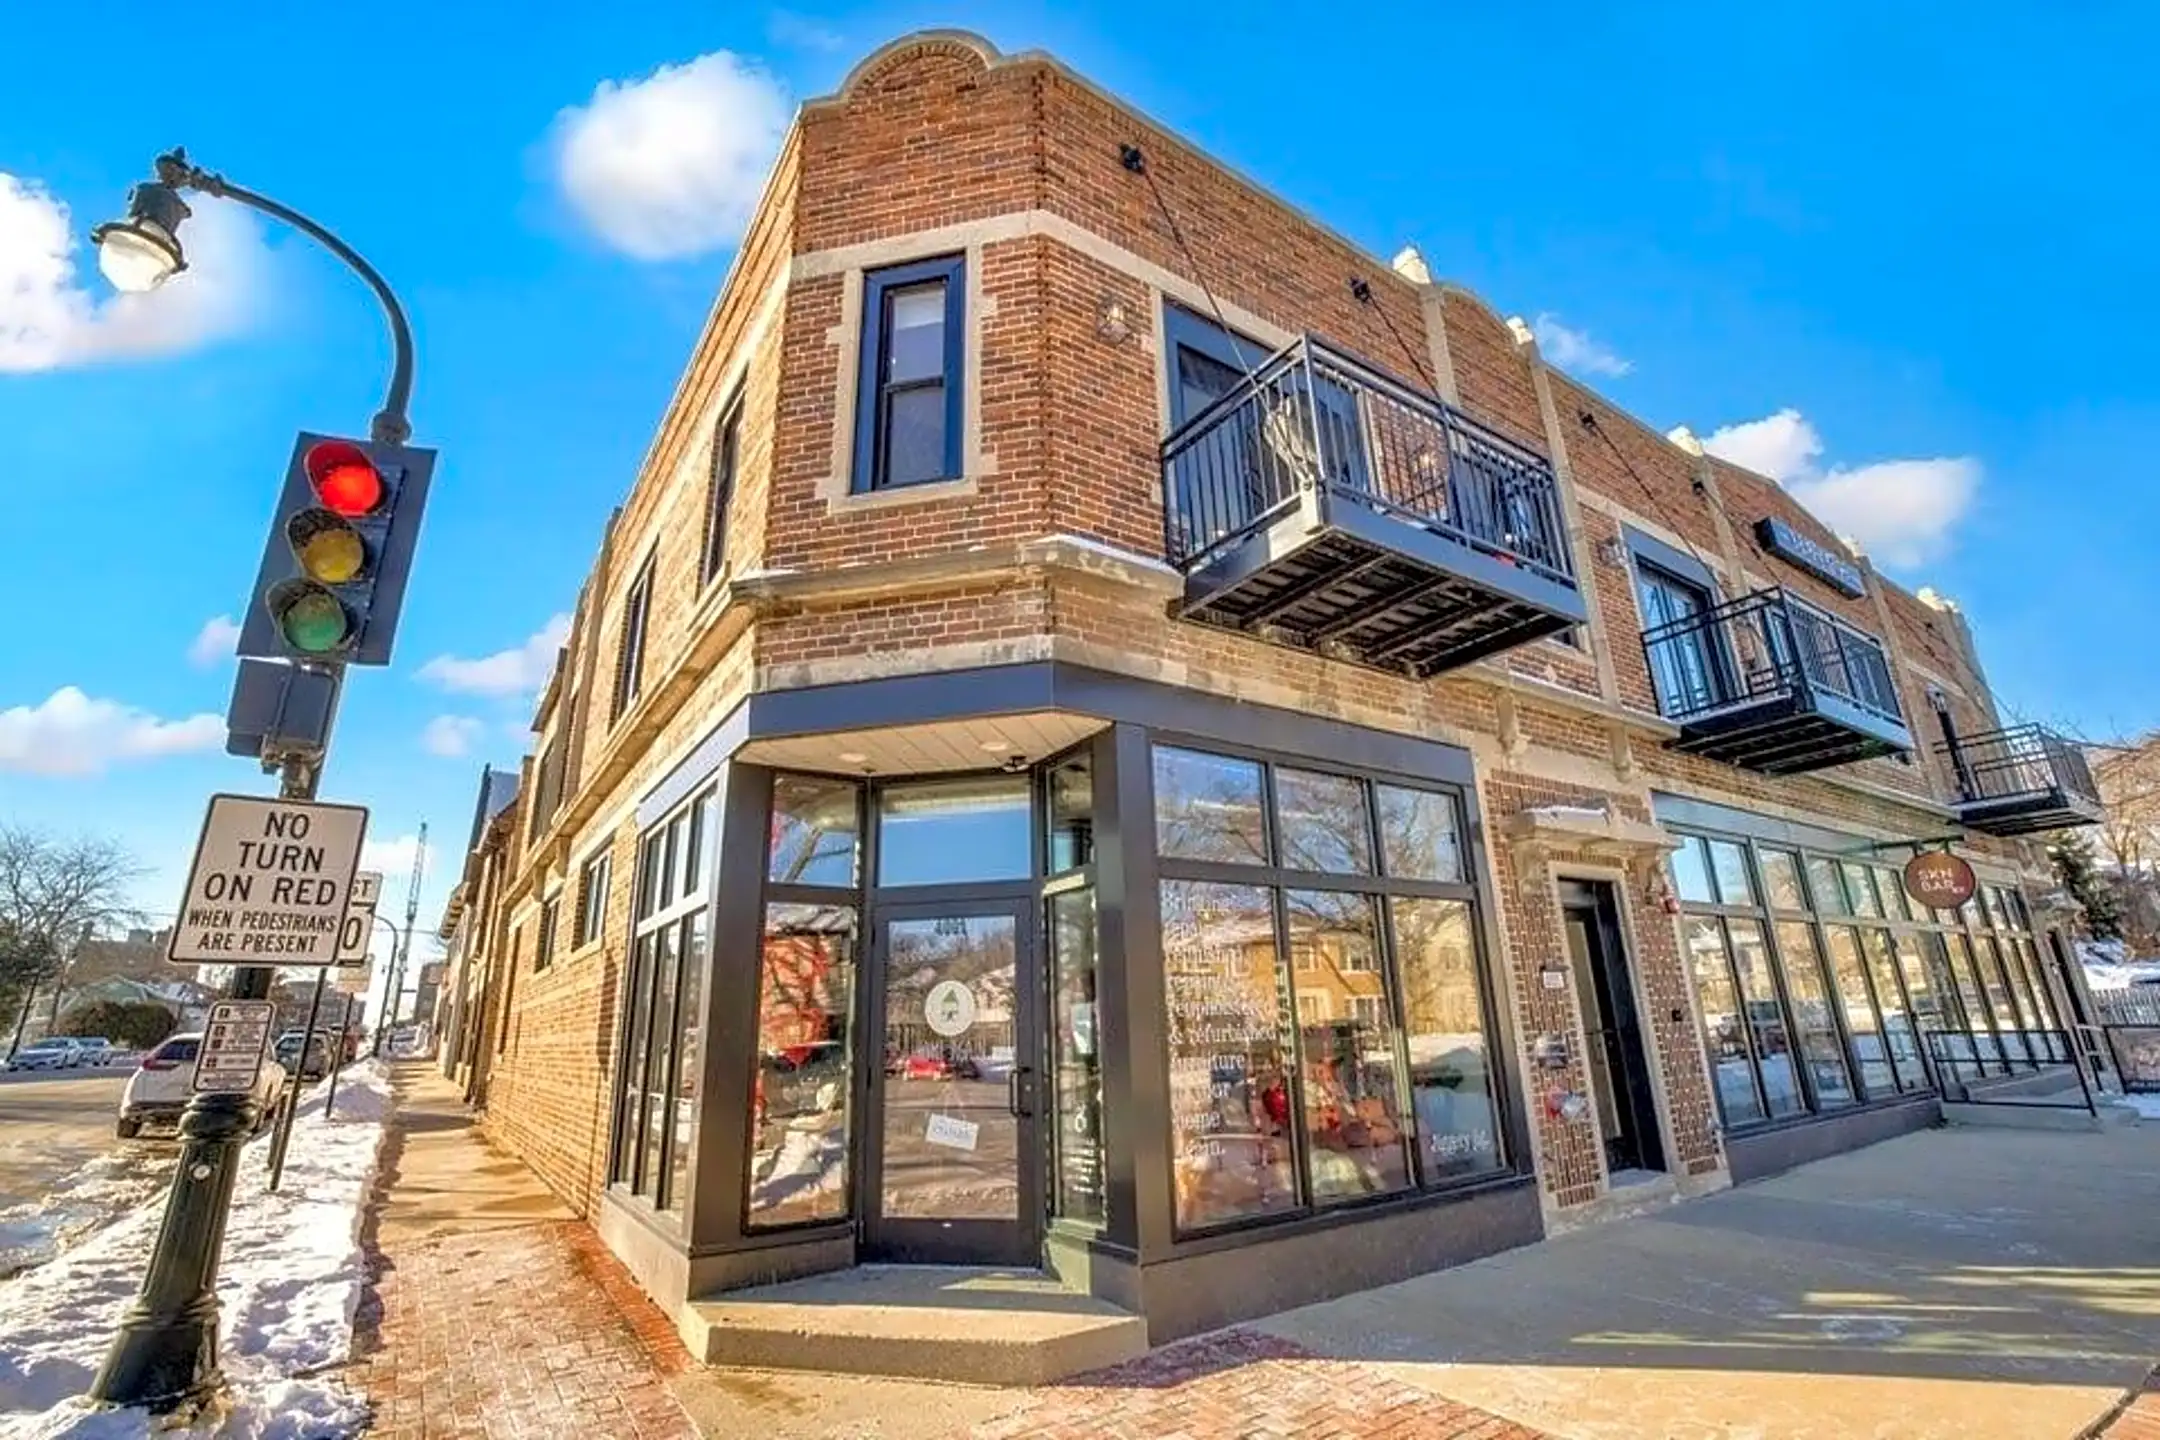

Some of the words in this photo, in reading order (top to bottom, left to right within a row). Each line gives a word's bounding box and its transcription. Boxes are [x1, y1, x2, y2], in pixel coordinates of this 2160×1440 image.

[265, 811, 309, 839] NO
[239, 841, 325, 873] TURN
[204, 873, 253, 901] ON
[272, 878, 336, 906] RED
[188, 909, 233, 930] WHEN
[240, 911, 337, 932] PEDESTRIANS
[197, 933, 234, 951] ARE
[239, 934, 318, 953] PRESENT
